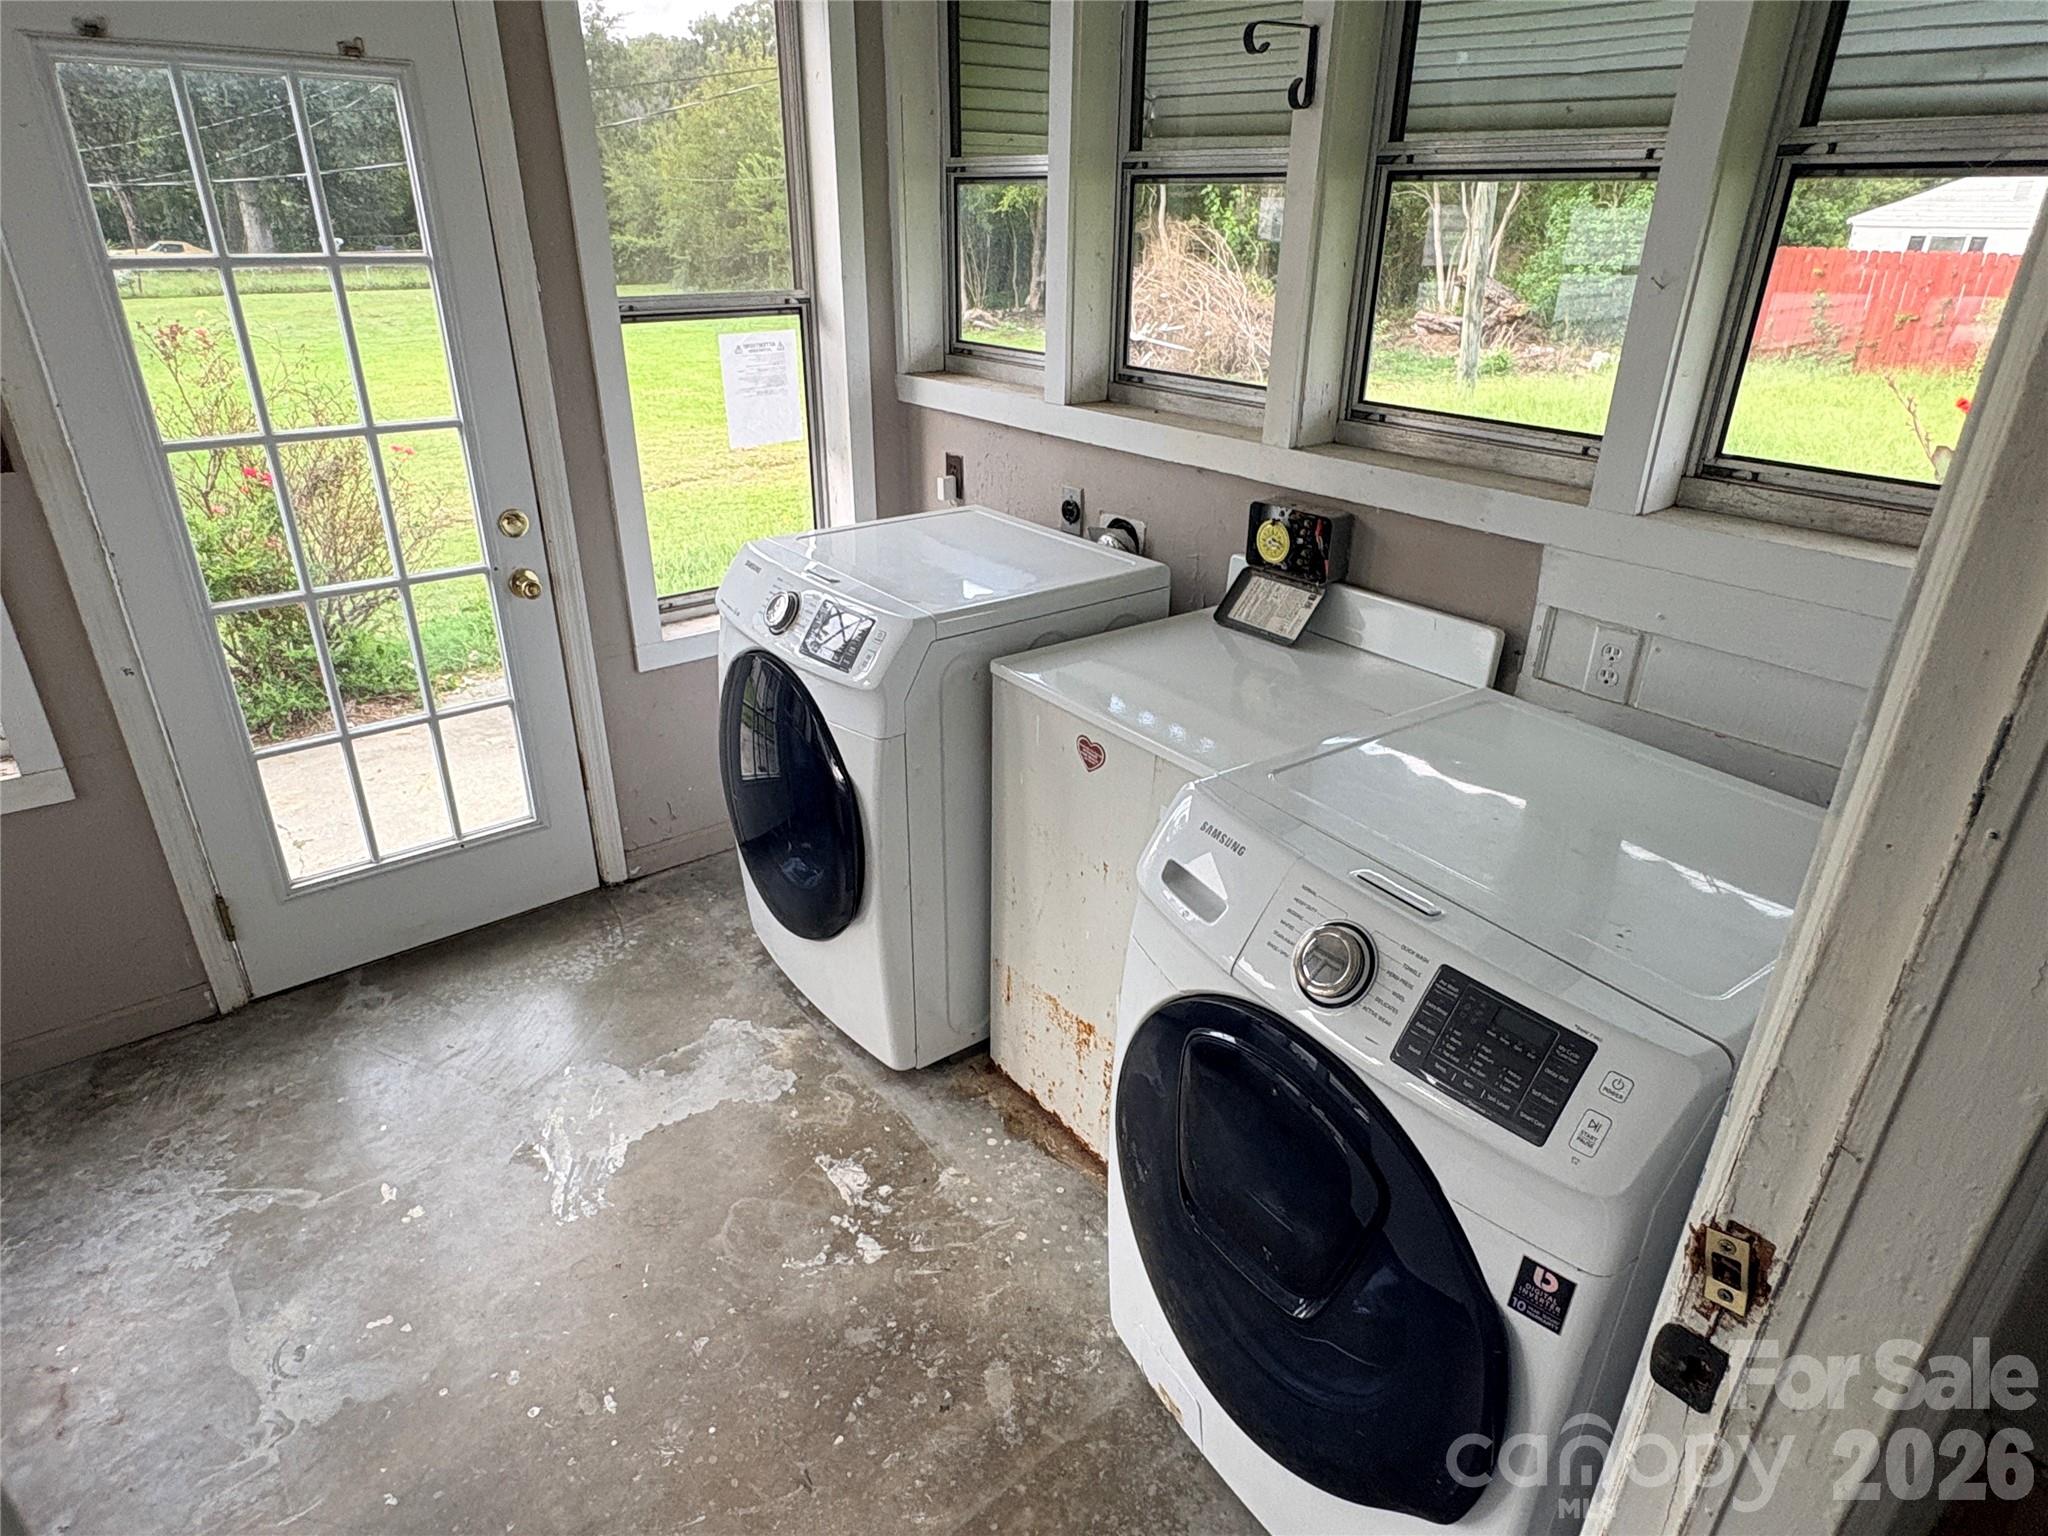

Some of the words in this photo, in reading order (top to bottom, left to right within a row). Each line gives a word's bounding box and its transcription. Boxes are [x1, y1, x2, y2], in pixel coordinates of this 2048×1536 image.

[1200, 821, 1246, 856] SAMSUNG
[1602, 1086, 1624, 1100] POWER
[1580, 1130, 1598, 1141] START
[1512, 1296, 1527, 1312] 10
[1518, 1285, 1561, 1313] INVERTER
[1525, 1282, 1558, 1306] DIGITAL
